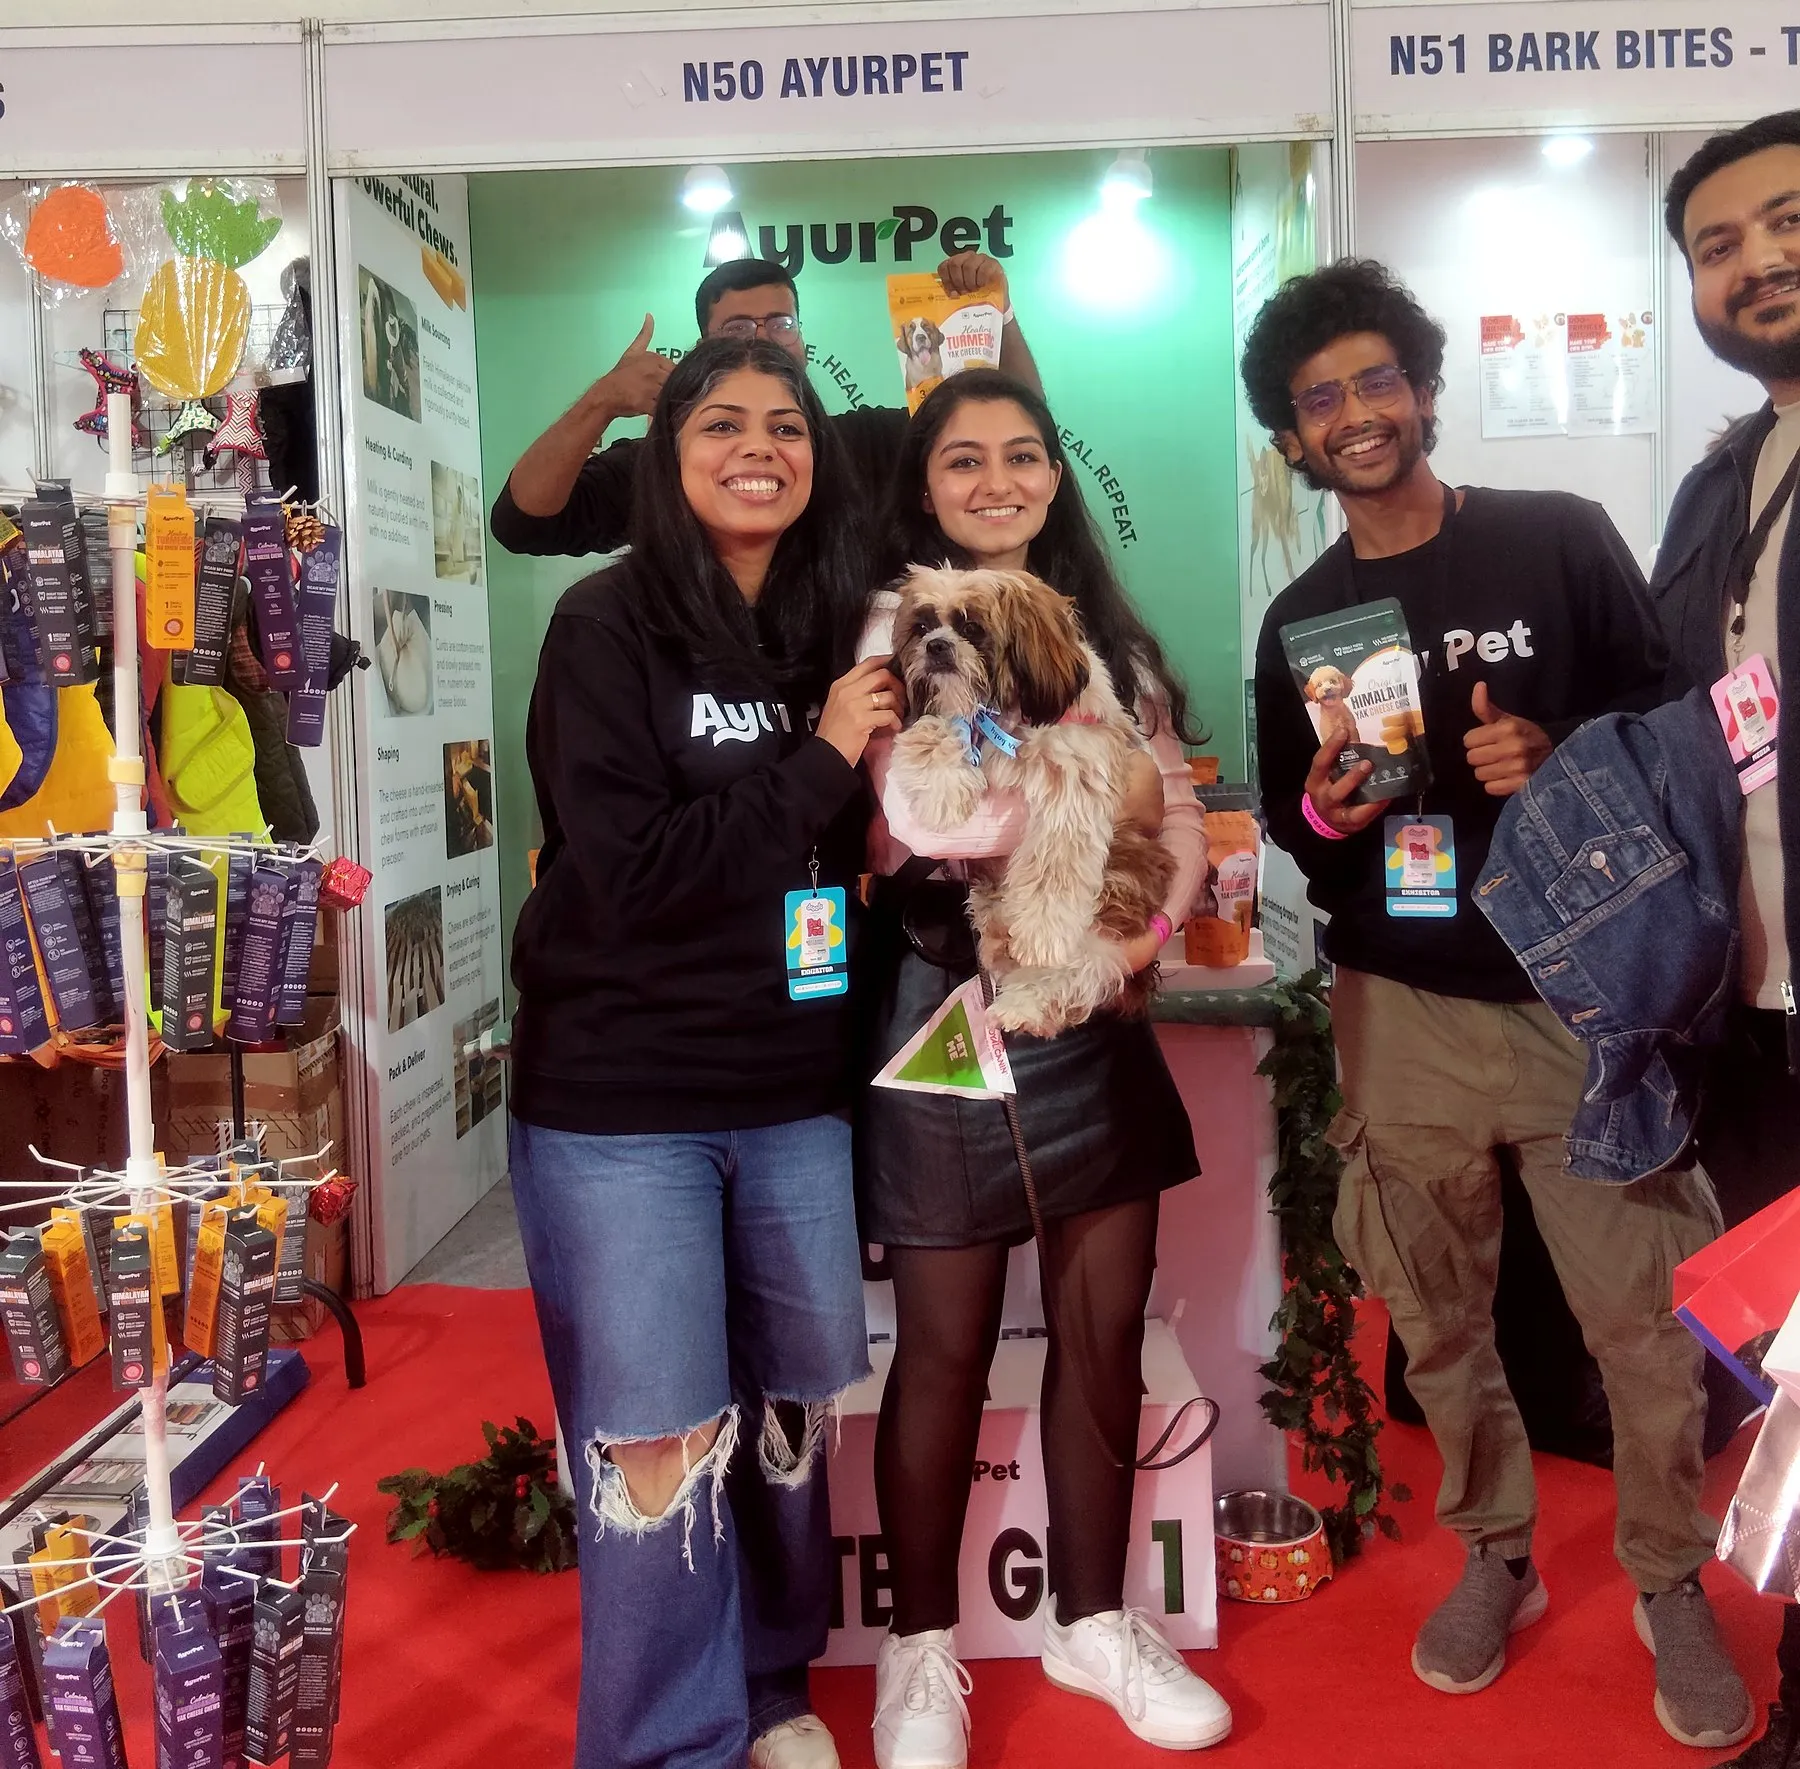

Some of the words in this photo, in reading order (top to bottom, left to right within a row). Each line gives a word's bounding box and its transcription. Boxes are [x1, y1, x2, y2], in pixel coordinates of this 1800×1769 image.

[1390, 34, 1466, 75] N51
[1487, 30, 1601, 73] BARK
[1616, 27, 1735, 69] BITES
[1750, 46, 1766, 56] -
[682, 62, 764, 102] N50
[780, 51, 969, 99] AYURPET
[418, 208, 458, 267] Chews.
[702, 204, 1015, 279] AyurPet
[960, 348, 981, 357] CHEESE
[919, 390, 926, 399] 3
[365, 436, 386, 461] Heating
[393, 447, 412, 471] Curding
[1057, 425, 1093, 470] EAL.
[1093, 464, 1137, 549] REPEAT.
[434, 600, 452, 617] Pressing
[1354, 710, 1369, 720] YAK
[1369, 703, 1394, 717] CHEESE
[378, 746, 400, 763] Shaping
[446, 881, 461, 899] Drying
[466, 875, 479, 890] Curing
[946, 1040, 959, 1061] ME
[953, 1033, 968, 1059] PET
[389, 1061, 402, 1081] Pack
[407, 1049, 426, 1070] Deliver
[177, 1714, 186, 1723] YAK
[187, 1707, 203, 1720] CHEESE
[204, 1702, 220, 1714] CHEWS
